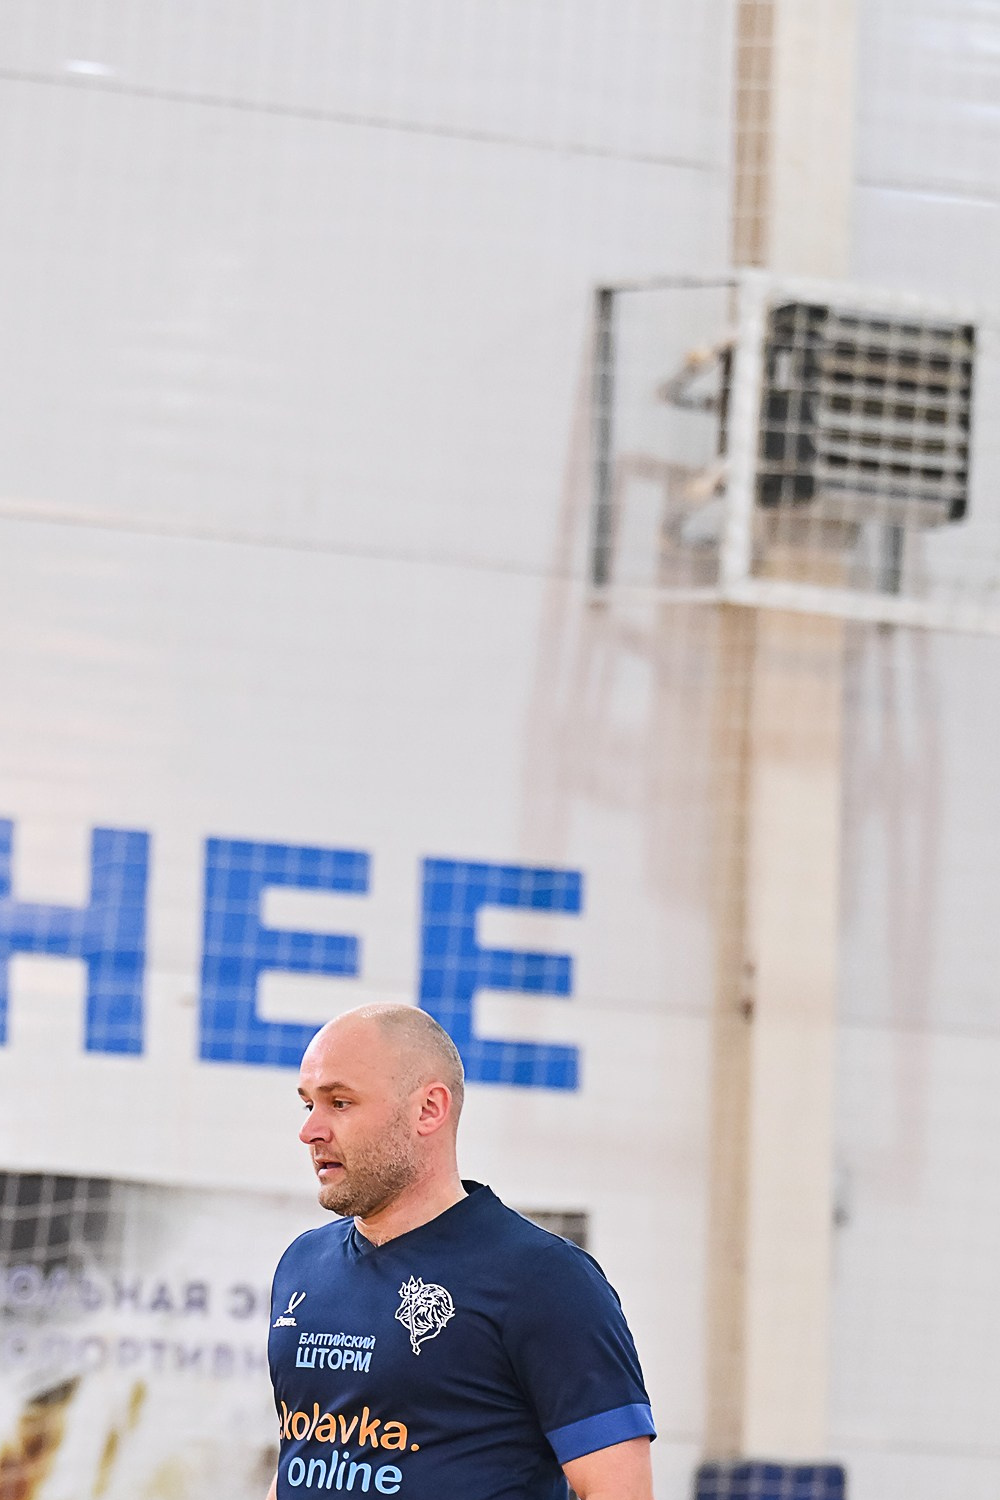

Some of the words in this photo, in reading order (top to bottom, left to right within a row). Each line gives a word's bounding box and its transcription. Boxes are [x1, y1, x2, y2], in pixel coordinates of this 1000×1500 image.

[298, 1332, 376, 1350] БАЛТИЙСКИЙ
[295, 1347, 373, 1373] ШТОРМ
[279, 1400, 420, 1452] kolavka.
[287, 1450, 403, 1495] online
